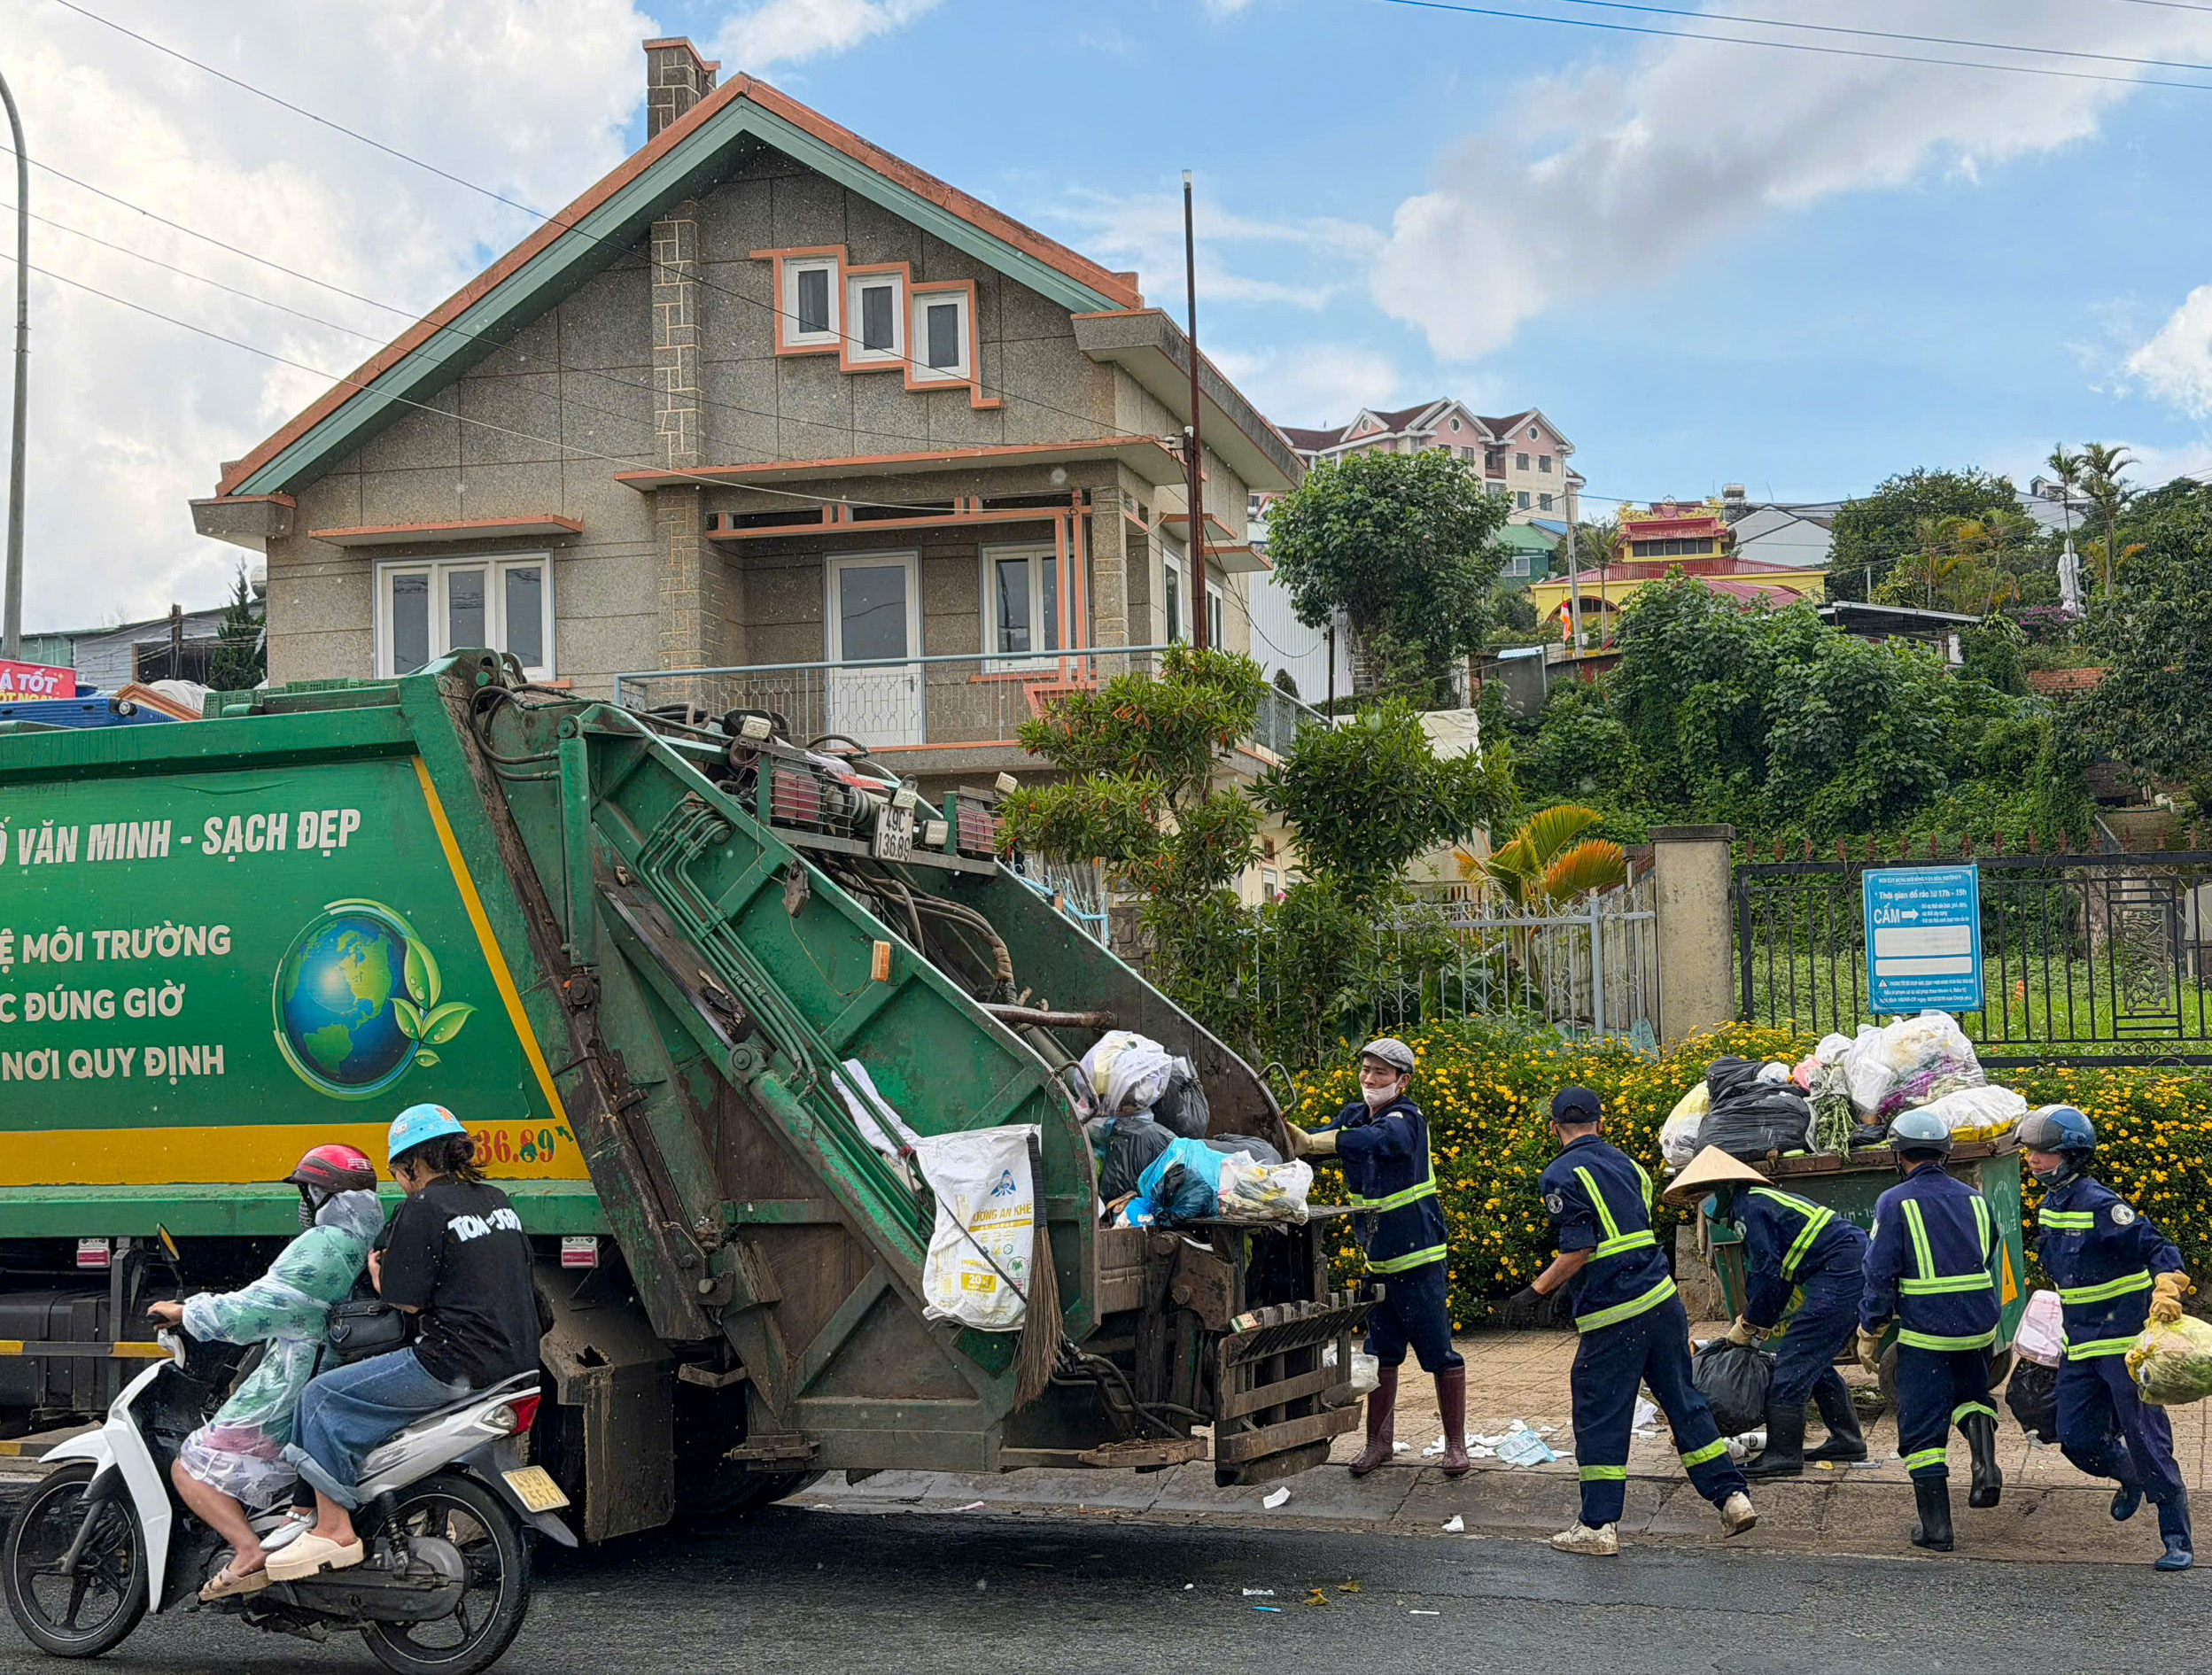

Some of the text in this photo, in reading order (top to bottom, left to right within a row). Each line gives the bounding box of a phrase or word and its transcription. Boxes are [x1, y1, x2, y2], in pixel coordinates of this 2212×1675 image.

[17, 668, 58, 694] TỐT
[886, 807, 905, 833] 49C
[18, 818, 79, 865] VĂN
[86, 819, 172, 862] MINH
[202, 812, 288, 862] SẠCH
[297, 809, 361, 857] ĐẸP
[879, 832, 911, 862] 136.89
[1874, 902, 1900, 924] CẤM
[23, 926, 83, 964] MÔI
[92, 919, 231, 960] TRƯỜNG
[25, 984, 115, 1022] ĐÚNG
[123, 979, 186, 1019] GIỜ
[2, 1044, 225, 1086] NƠI QUY ĐỊNH
[447, 1214, 492, 1242] TOM
